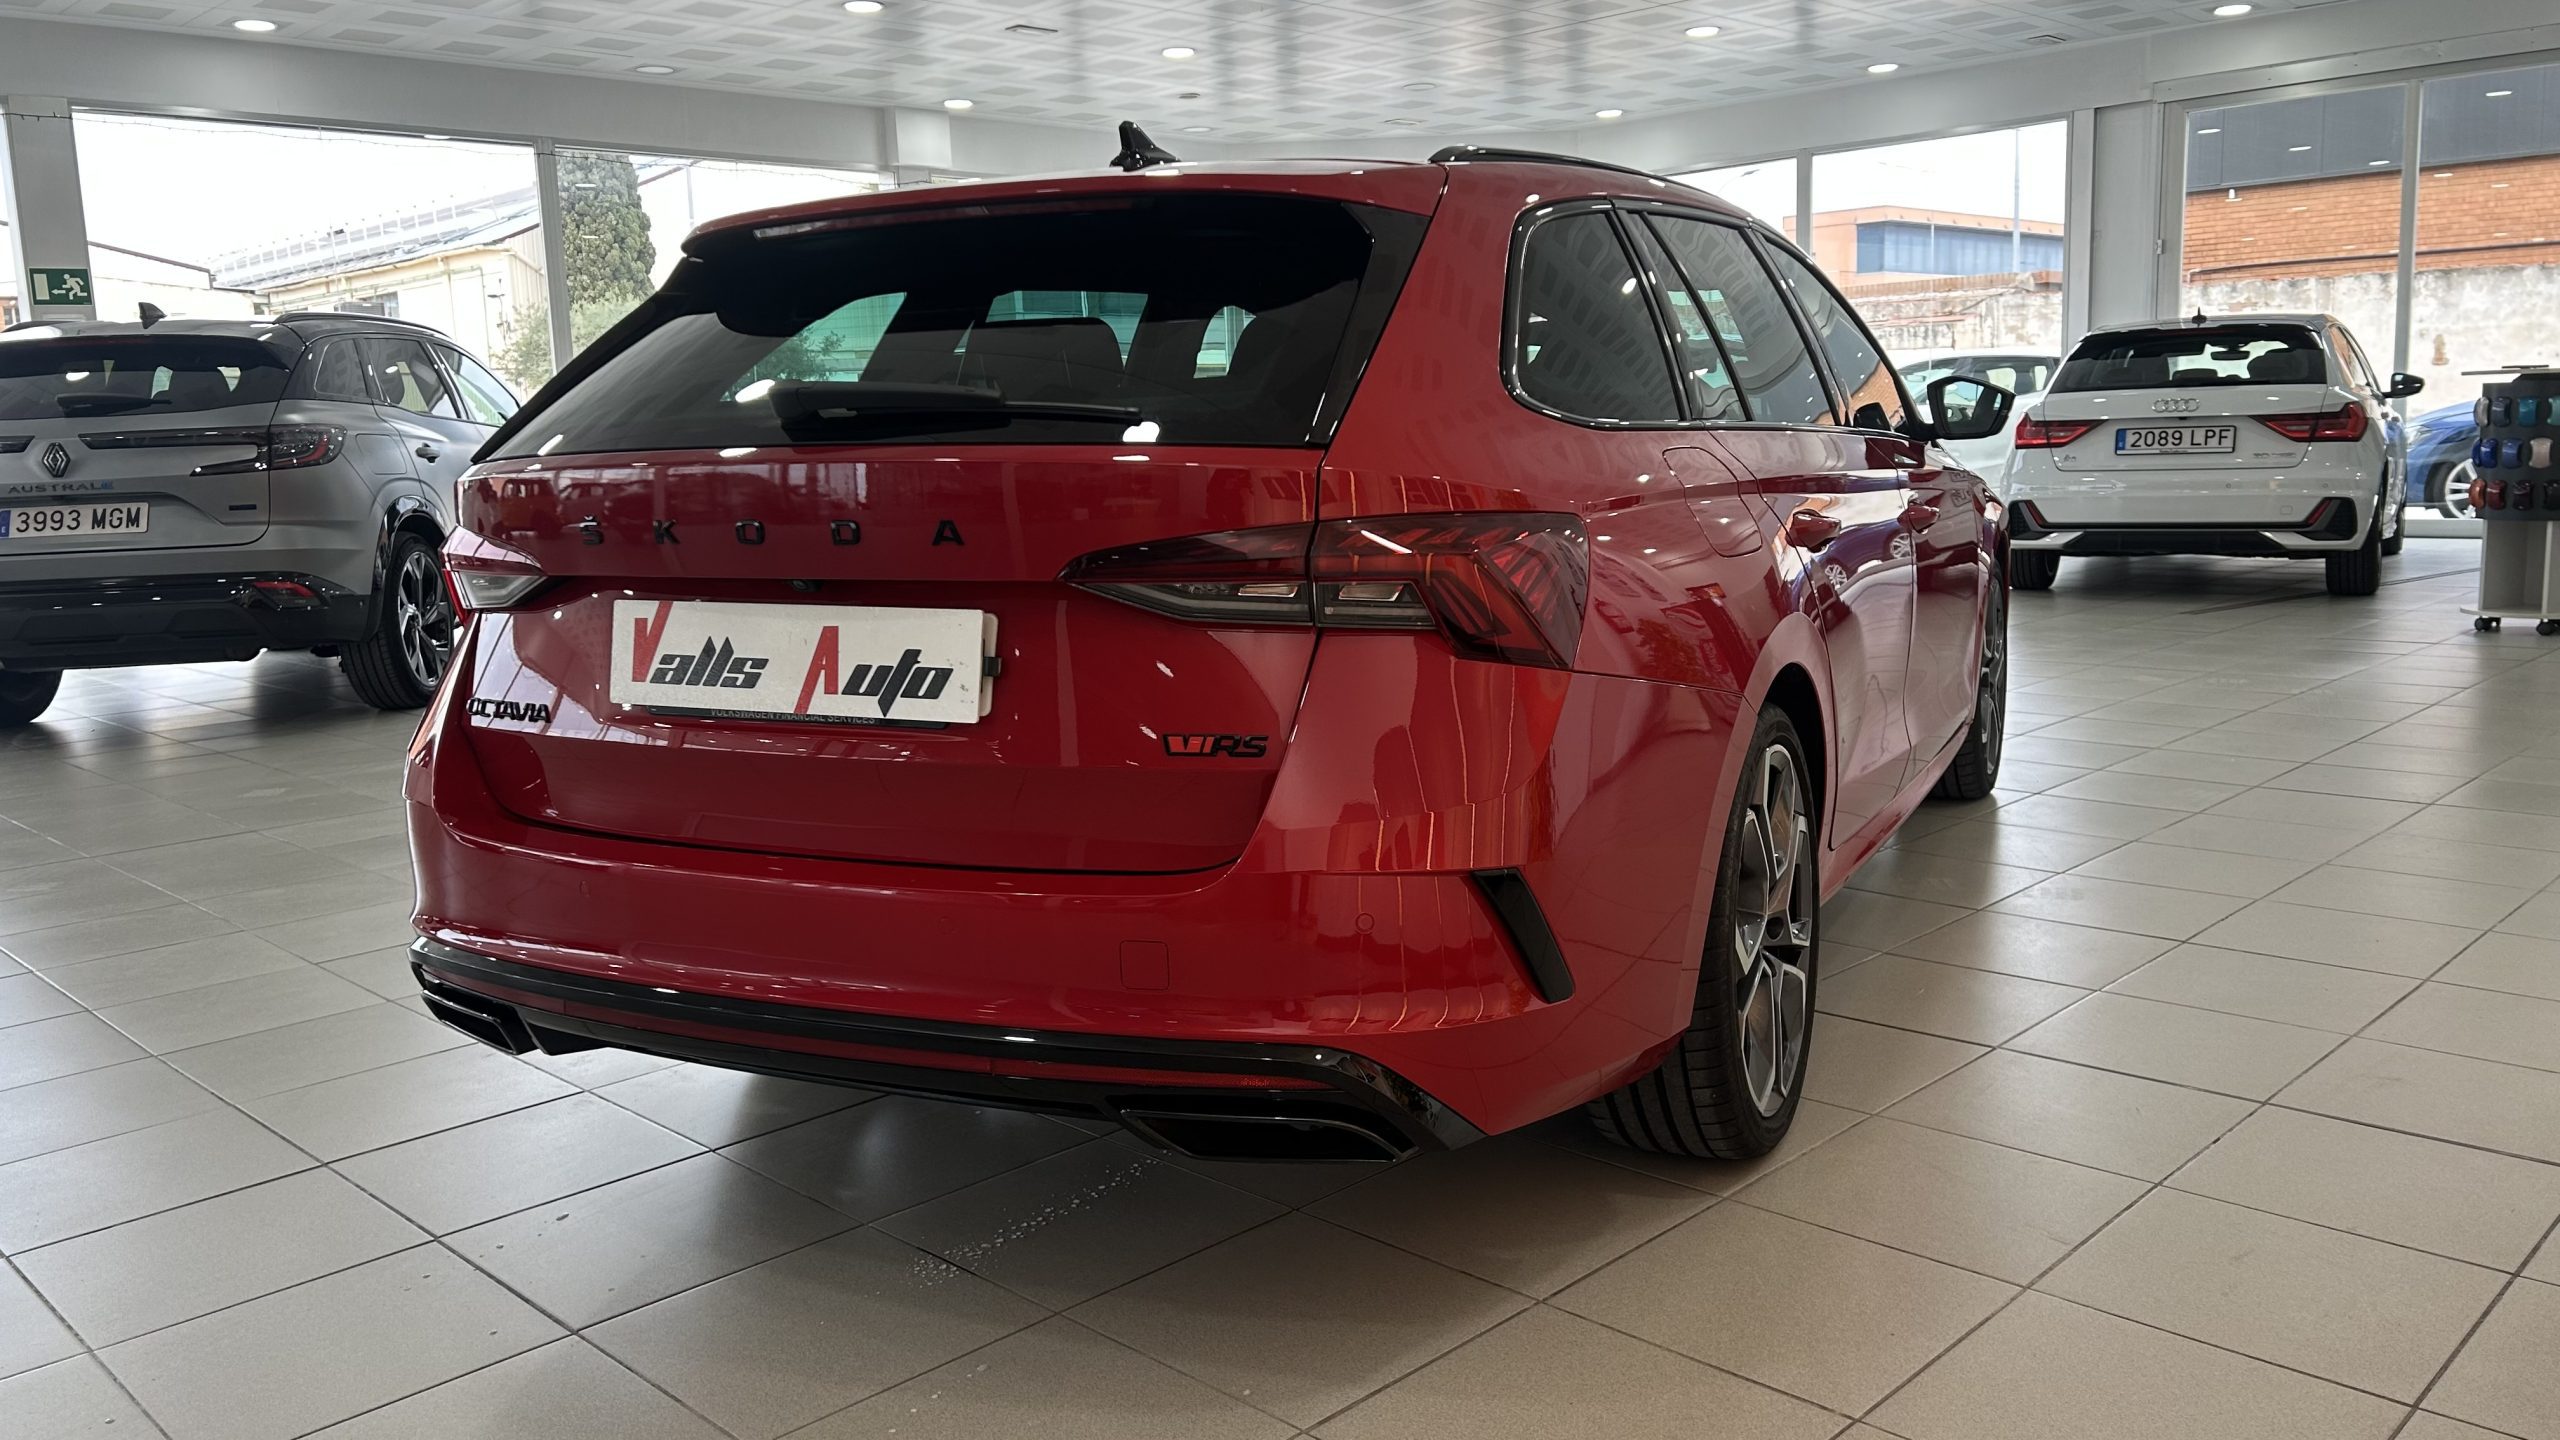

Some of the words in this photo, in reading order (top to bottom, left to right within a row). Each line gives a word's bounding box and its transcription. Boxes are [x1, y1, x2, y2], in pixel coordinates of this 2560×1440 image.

[2130, 430, 2183, 448] 2089
[2190, 429, 2231, 446] LPF
[16, 509, 81, 533] 3993
[91, 507, 141, 530] MGM
[631, 600, 770, 689] Valls
[793, 625, 954, 718] Auto
[466, 698, 552, 724] OCTAVIA
[711, 709, 773, 719] VOLKSWAGEN
[776, 713, 825, 722] FINANCIAL
[827, 715, 875, 724] SERVICES
